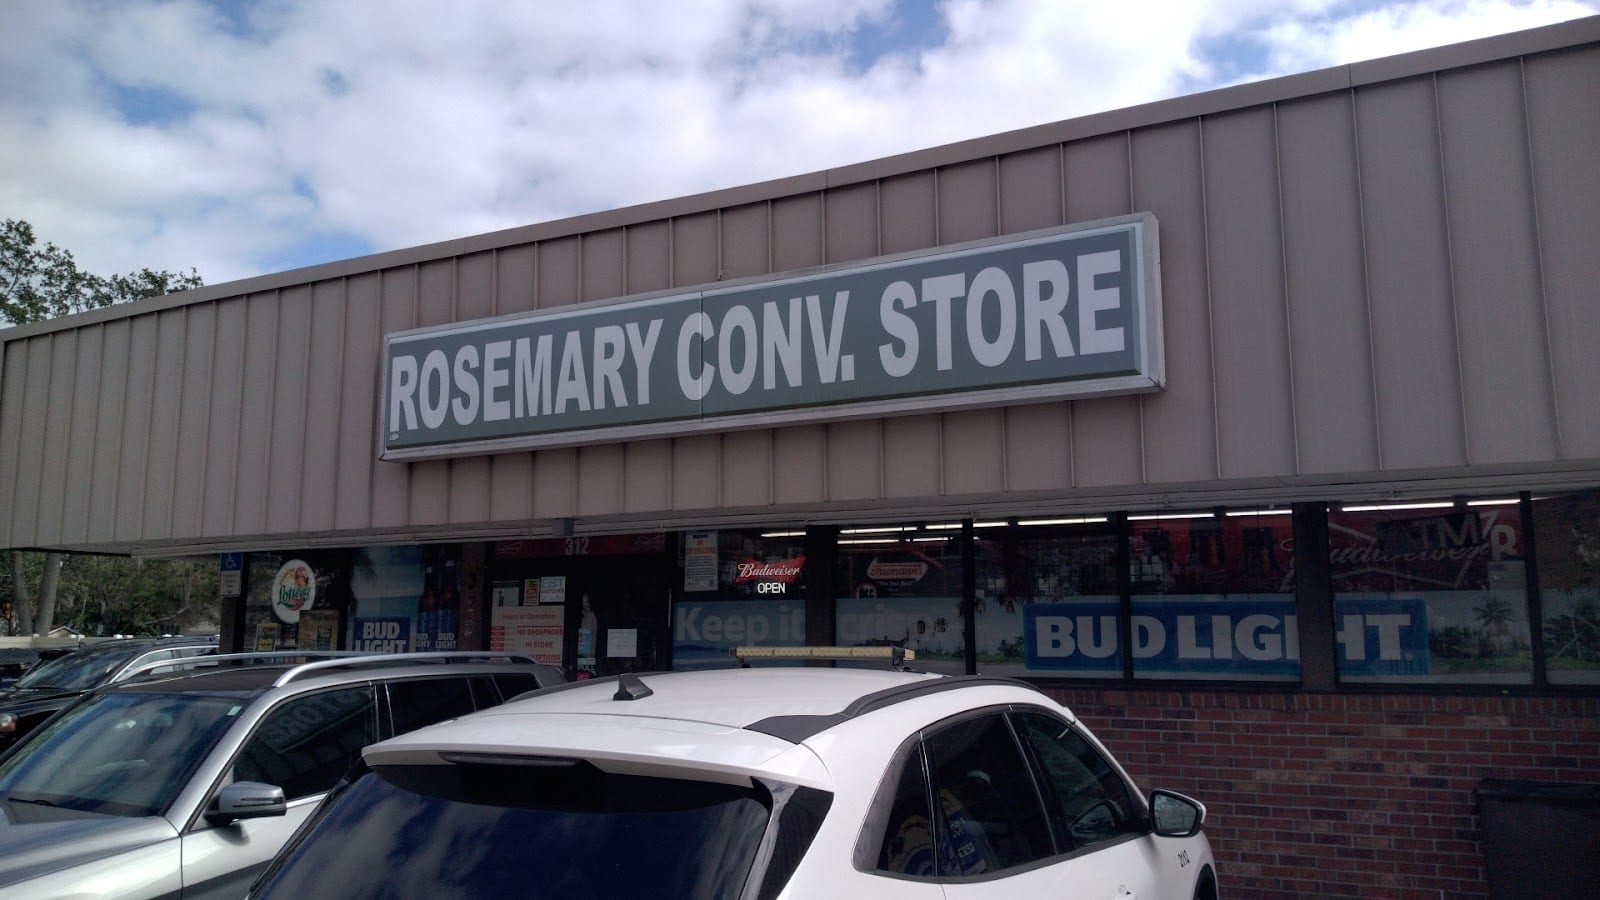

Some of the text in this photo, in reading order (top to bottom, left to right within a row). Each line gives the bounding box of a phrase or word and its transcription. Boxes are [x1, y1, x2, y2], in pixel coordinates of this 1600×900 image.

[389, 249, 1125, 432] ROSEMARY CONV. STORE
[563, 537, 591, 556] 312
[737, 563, 800, 578] Budweiser
[757, 582, 786, 594] OPEN
[363, 622, 401, 640] BUD
[677, 607, 769, 648] Keep
[780, 604, 806, 642] it
[414, 633, 429, 641] UD
[437, 633, 456, 641] BUD
[1035, 614, 1411, 661] BUD LIGHT
[354, 640, 407, 653] LIGHT
[435, 641, 457, 649] LIGHT
